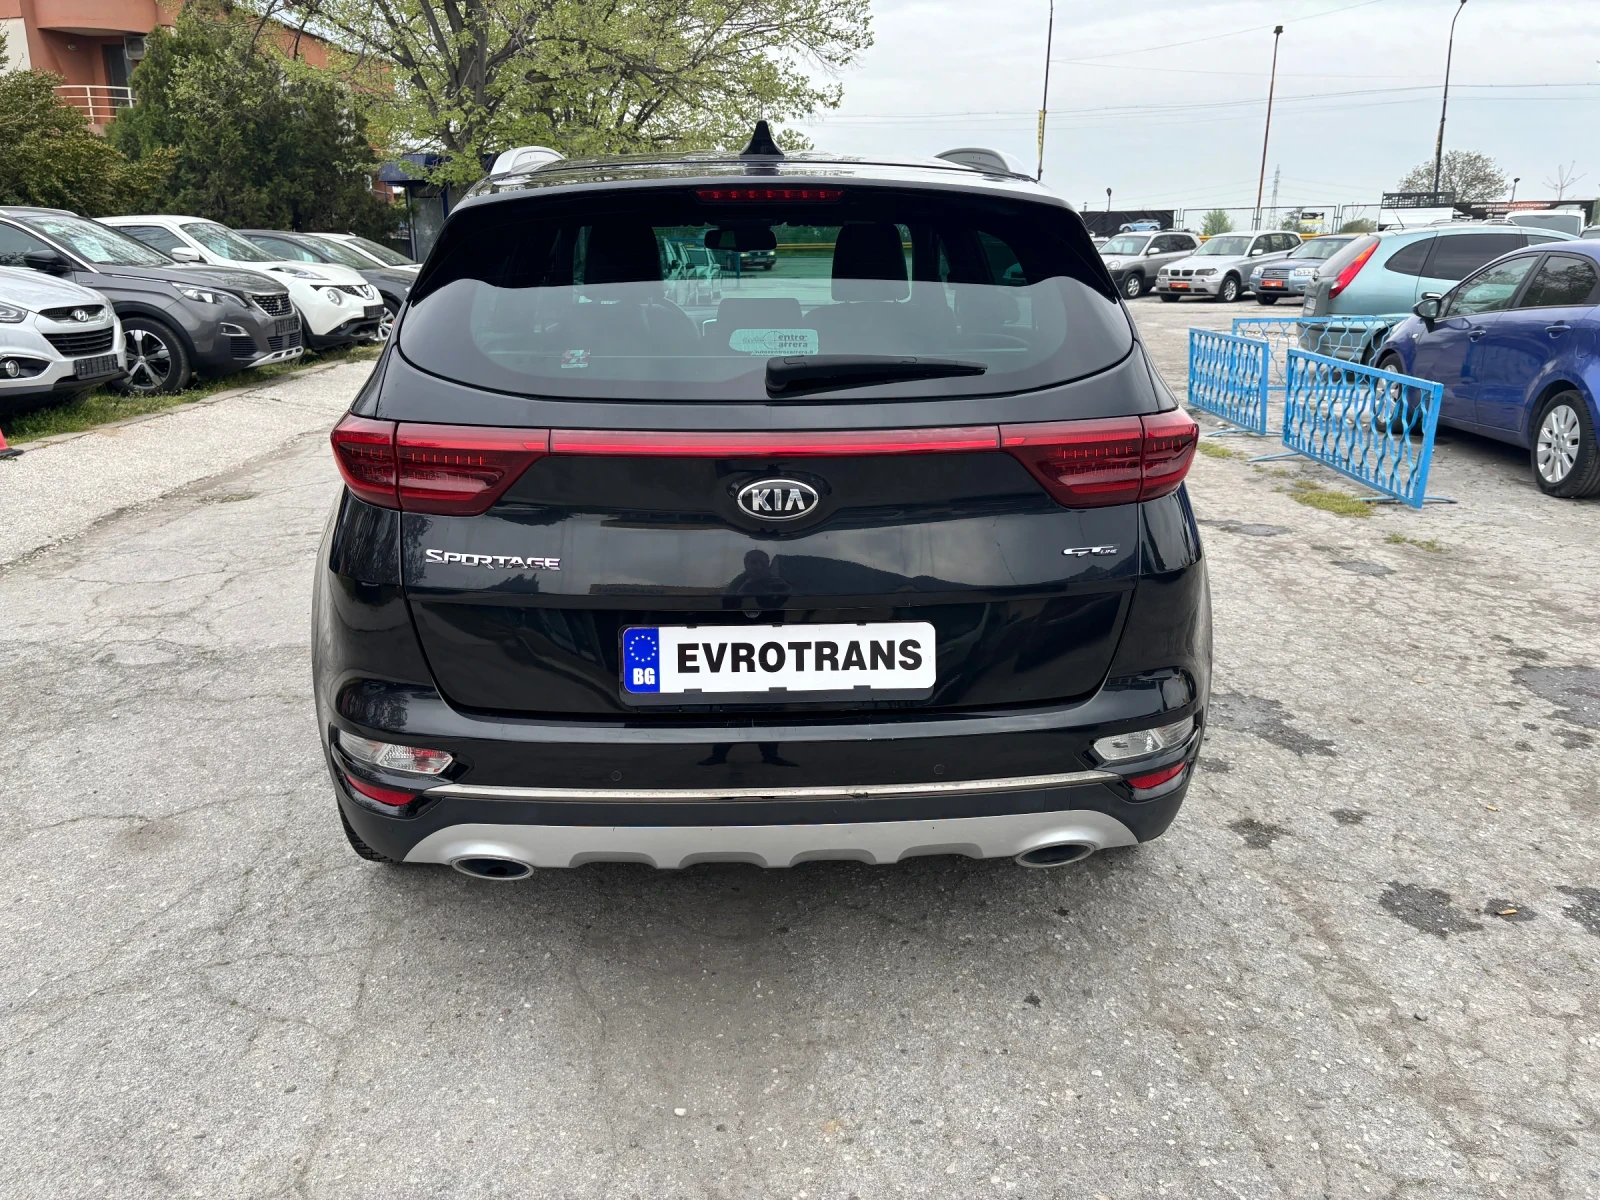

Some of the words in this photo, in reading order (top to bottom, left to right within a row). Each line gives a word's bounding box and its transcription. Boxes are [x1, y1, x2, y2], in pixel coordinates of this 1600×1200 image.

[751, 488, 805, 511] KIA
[425, 549, 561, 570] SPORTAGE
[677, 639, 922, 673] EVROTRANS
[633, 668, 655, 685] BG
